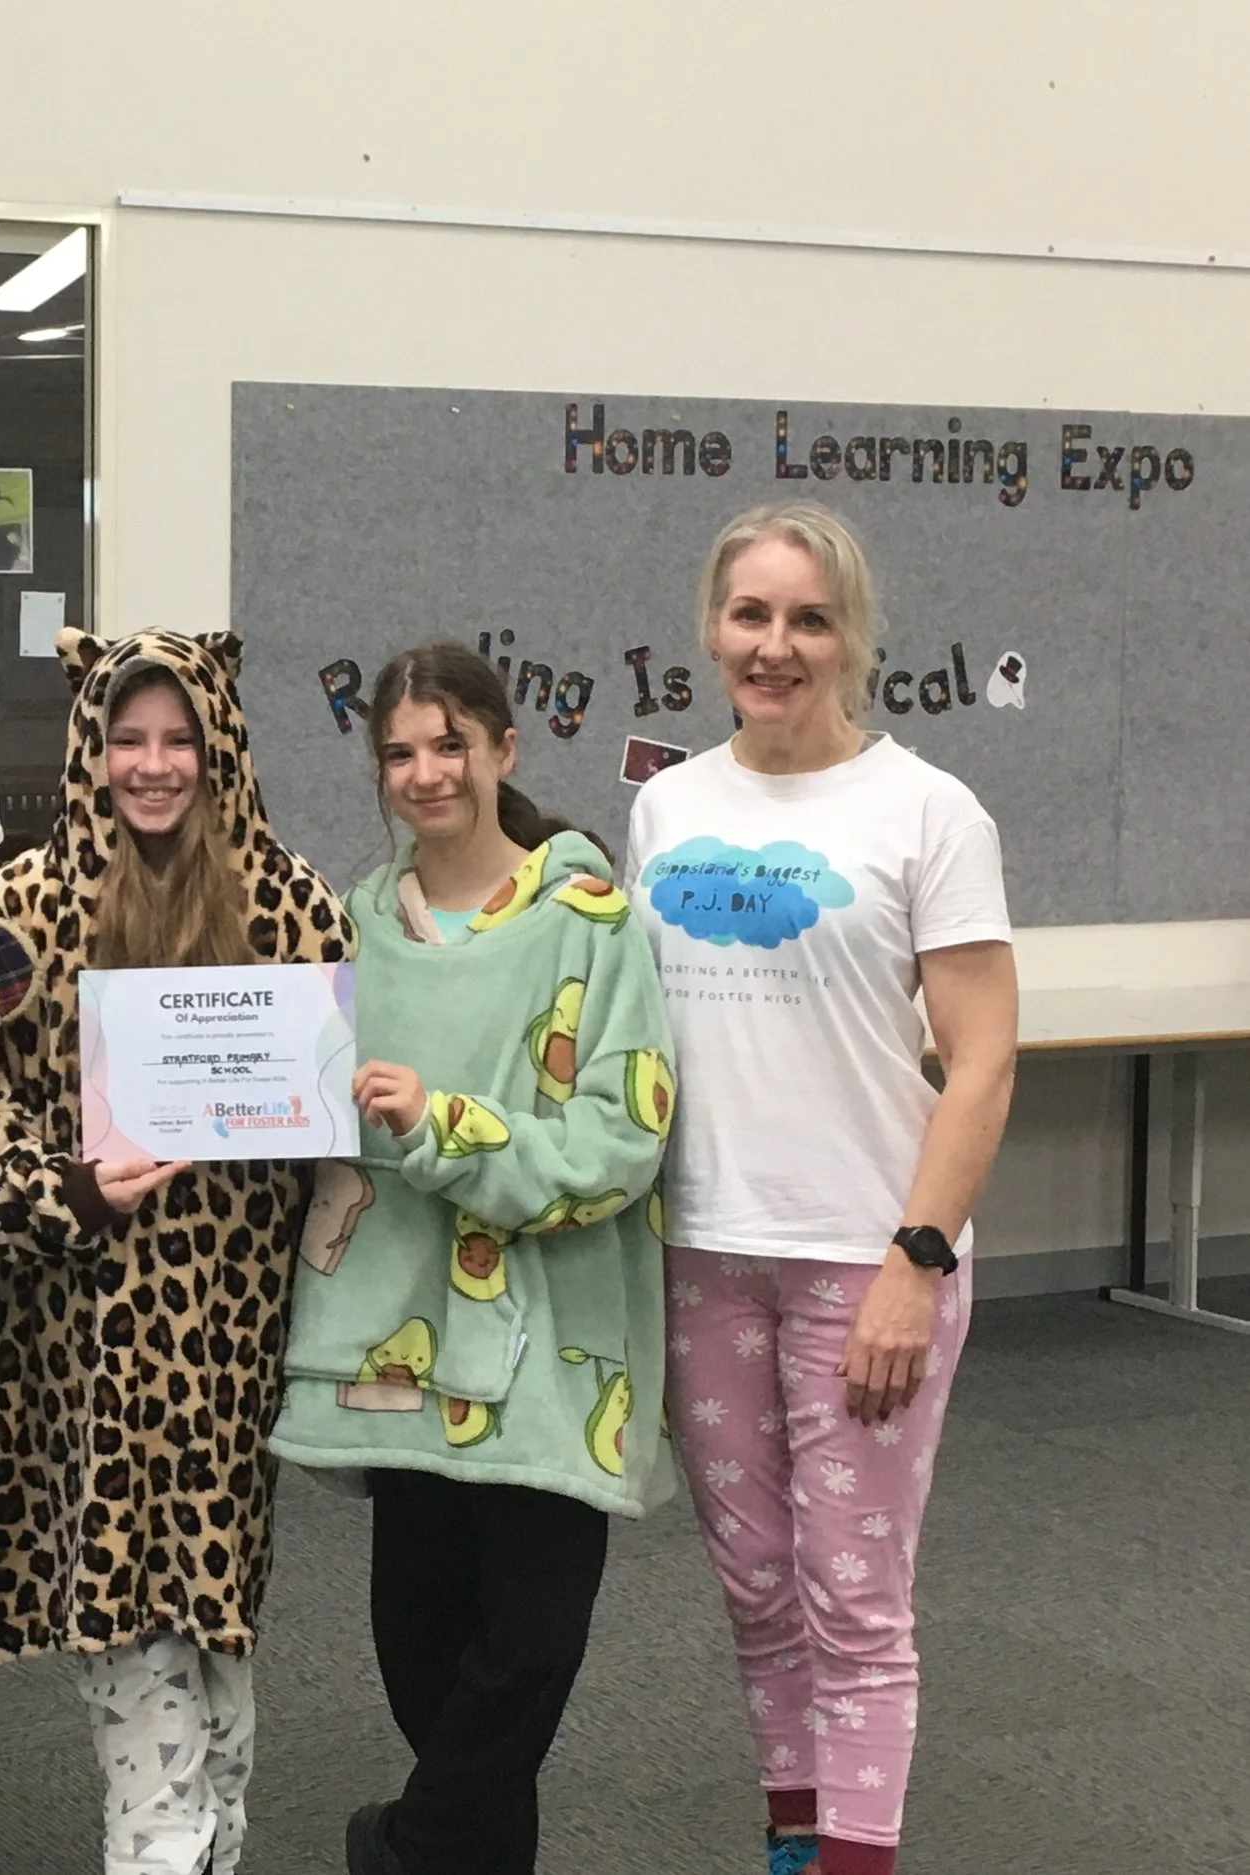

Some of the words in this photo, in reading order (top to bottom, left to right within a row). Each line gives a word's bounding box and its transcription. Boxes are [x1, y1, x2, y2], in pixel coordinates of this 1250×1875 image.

[564, 403, 733, 477] Home
[775, 410, 1028, 507] Learning
[1060, 424, 1195, 510] Expo
[318, 629, 594, 739] Ring
[624, 645, 693, 718] Is
[654, 861, 750, 880] Gippsland's
[754, 865, 823, 887] Biggest
[681, 889, 722, 912] P.J.
[730, 892, 775, 914] DAY
[664, 964, 718, 977] ORTING
[726, 967, 735, 977] A
[743, 967, 799, 980] BETTER
[159, 990, 274, 1010] CERTIFICATE
[664, 988, 690, 999] FOR
[698, 990, 754, 1003] FOSTER
[764, 994, 803, 1006] KIDS
[175, 1013, 189, 1023] Of
[190, 1012, 259, 1025] Appreciation
[161, 1053, 221, 1068] STRATFORD
[226, 1051, 270, 1064] PRIMARY
[210, 1065, 253, 1076] SCHOOL
[225, 1117, 245, 1129] FOR
[248, 1116, 285, 1128] FOSTER
[287, 1115, 311, 1128] KIDS
